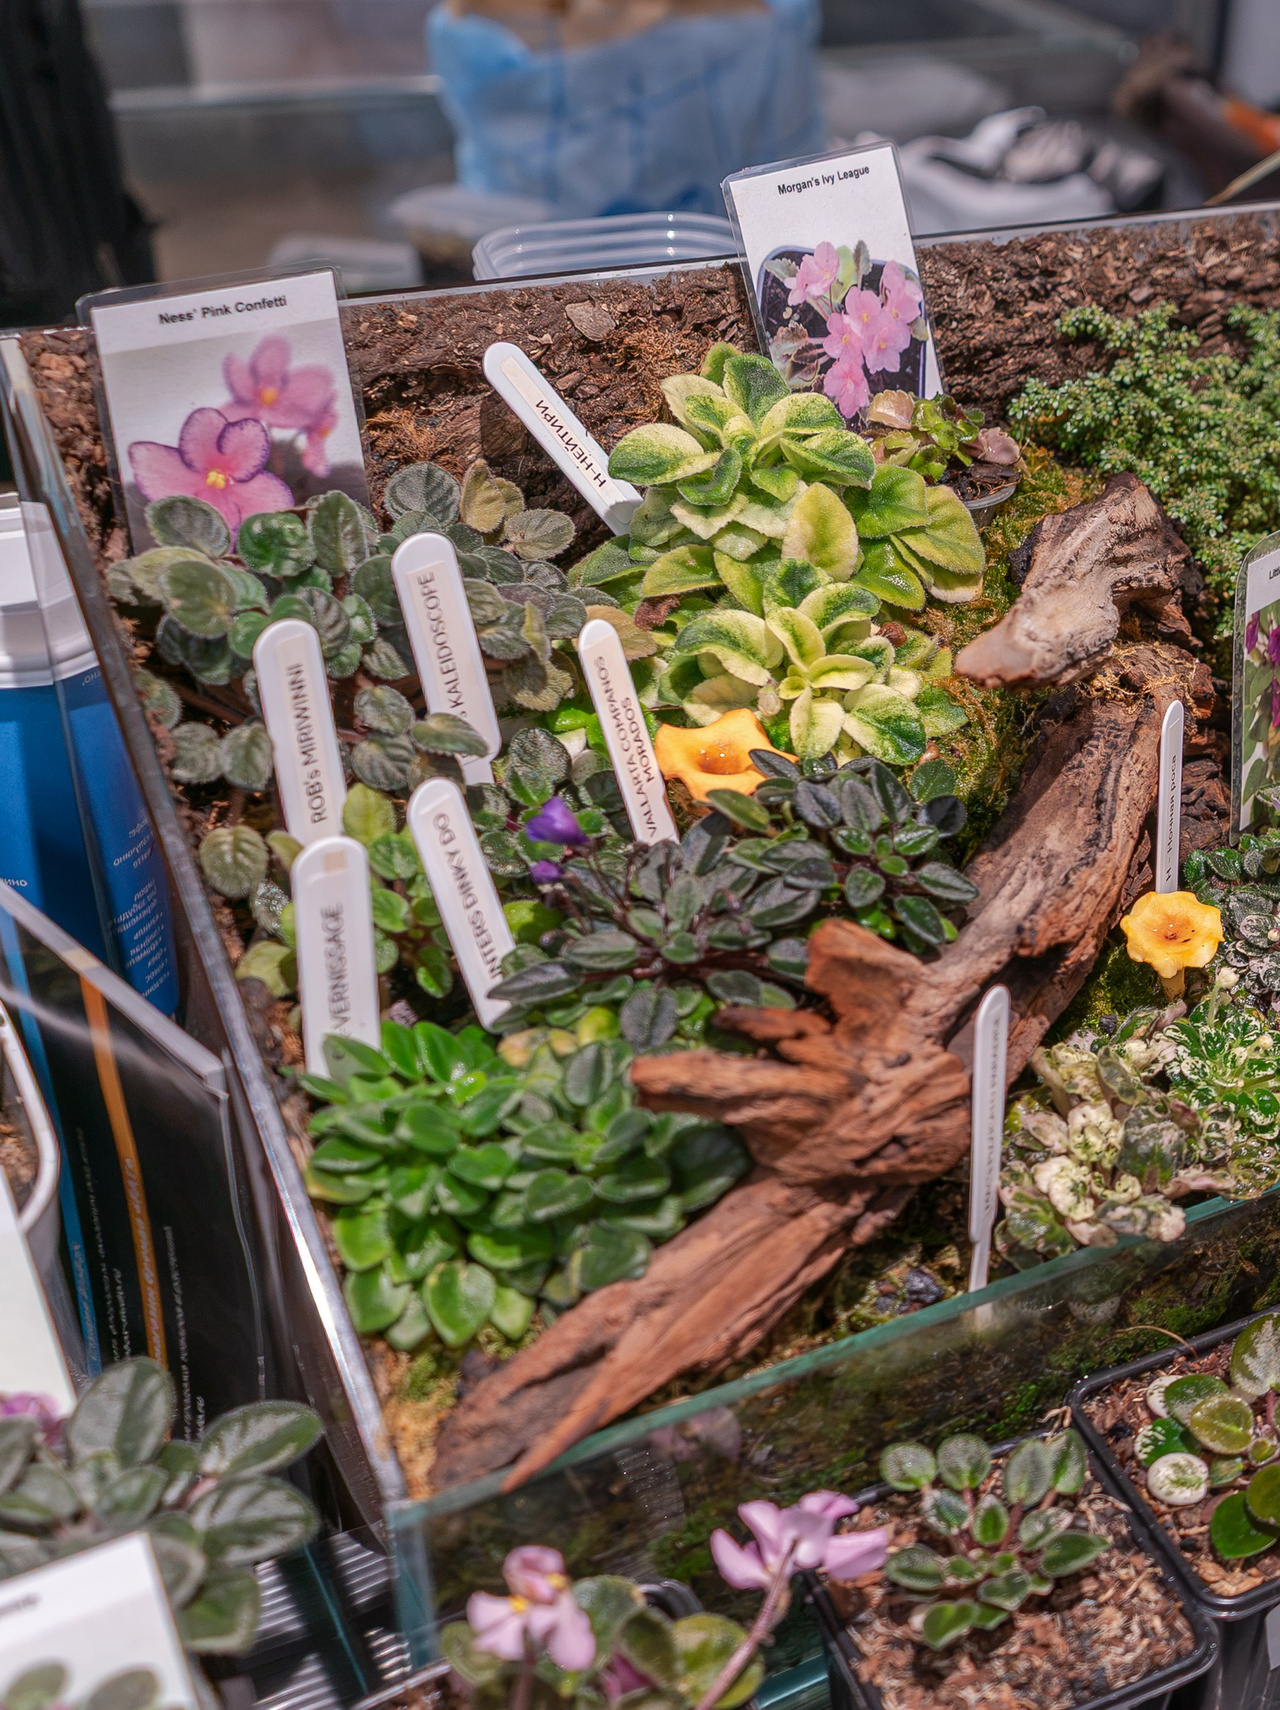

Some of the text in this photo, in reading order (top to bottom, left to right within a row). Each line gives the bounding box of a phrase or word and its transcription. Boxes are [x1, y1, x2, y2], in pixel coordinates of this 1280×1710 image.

[777, 166, 870, 195] Morgan's Ivy League
[201, 304, 232, 318] Pink
[234, 295, 287, 313] Confetti
[535, 399, 607, 488] Н-НЕЙТИРИ
[416, 571, 465, 709] KALEIDOSCOPE
[286, 663, 328, 824] ROB's MIRIWINNI
[594, 656, 658, 838] VALLARTA COMPANOS
[621, 697, 655, 783] MORADOS
[1166, 795, 1175, 854] Ночная
[432, 812, 502, 979] NTERS DINKY DO
